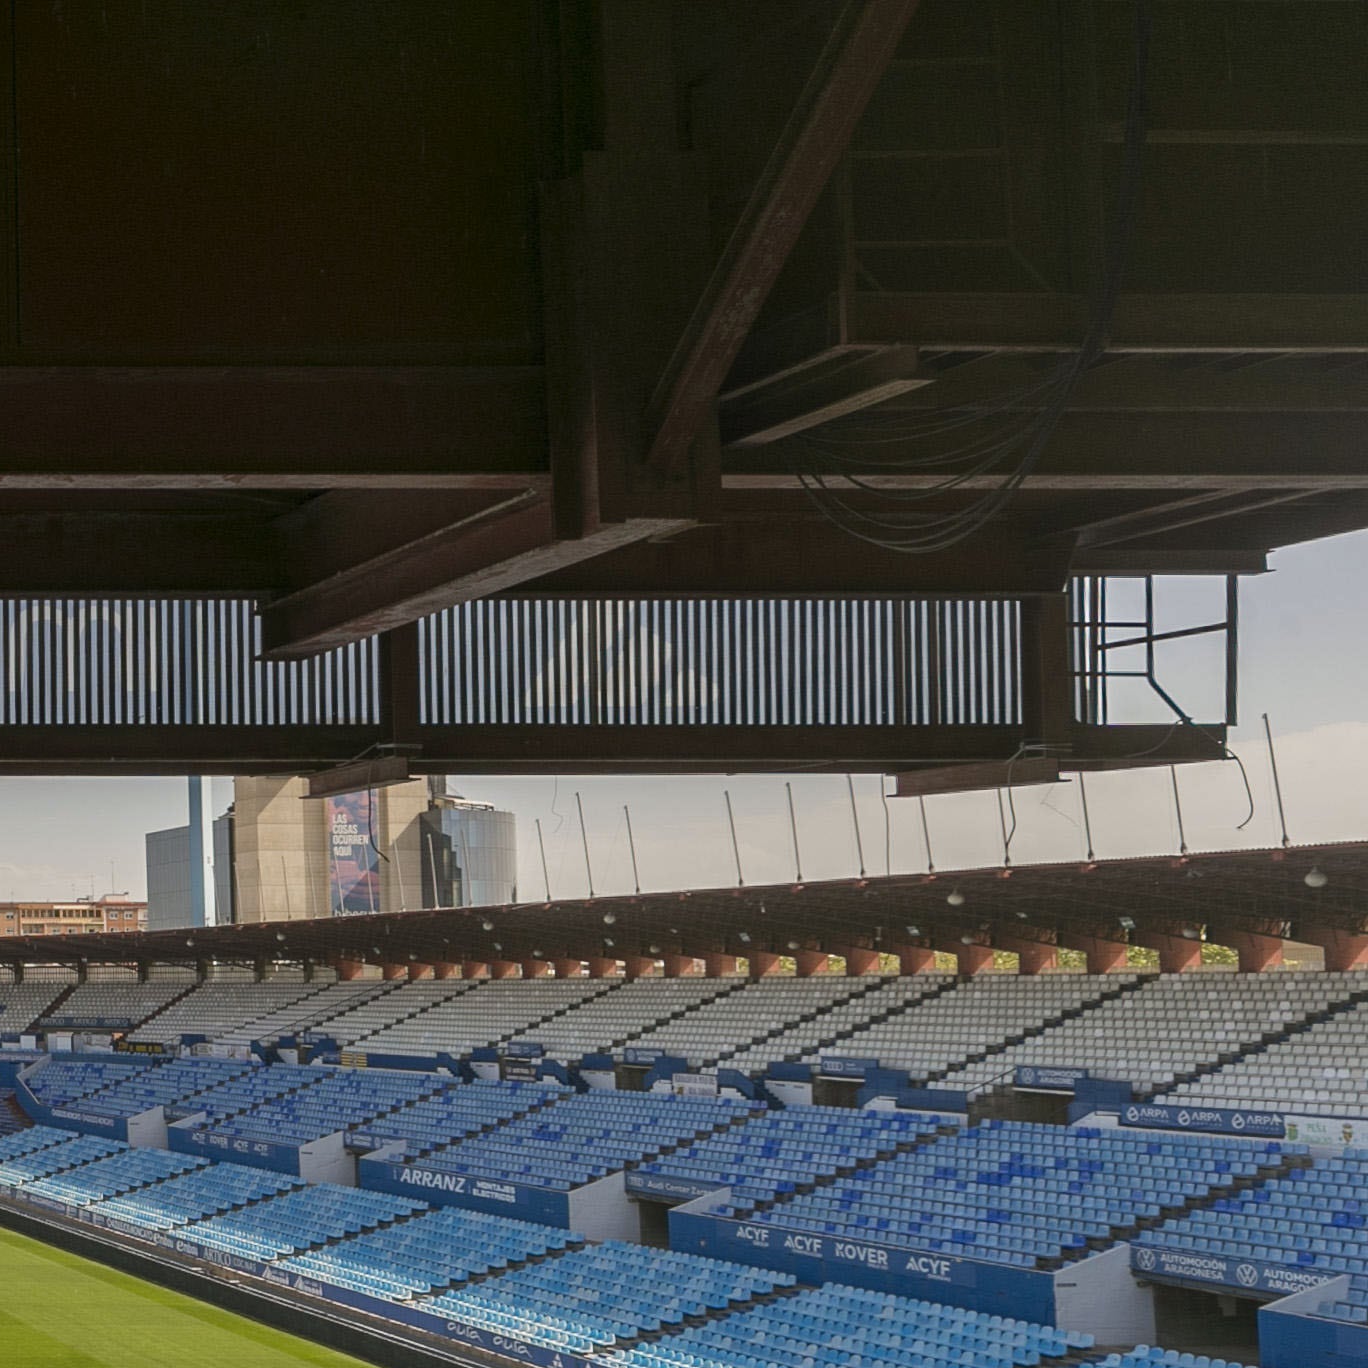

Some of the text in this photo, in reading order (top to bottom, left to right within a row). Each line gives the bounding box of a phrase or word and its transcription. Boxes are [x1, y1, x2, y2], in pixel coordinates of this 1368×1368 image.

[332, 814, 347, 824] LAS
[332, 825, 358, 834] COSAS
[1140, 1107, 1169, 1119] ARPA
[1191, 1111, 1222, 1122] ARPA
[1246, 1114, 1282, 1126] ARPA
[400, 1168, 466, 1193] ARRANZ
[476, 1180, 515, 1195] MONTAJES
[648, 1180, 664, 1190] Audi
[665, 1183, 690, 1193] Center
[736, 1226, 769, 1242] ACYF
[784, 1235, 822, 1252] ACYF
[835, 1242, 889, 1266] KOVER
[906, 1255, 952, 1276] ACYF
[1160, 1253, 1227, 1272] AUTOMOCIÓN
[1164, 1264, 1225, 1281] ARAGONESA
[1264, 1268, 1330, 1284] AUTOMOCIÓ
